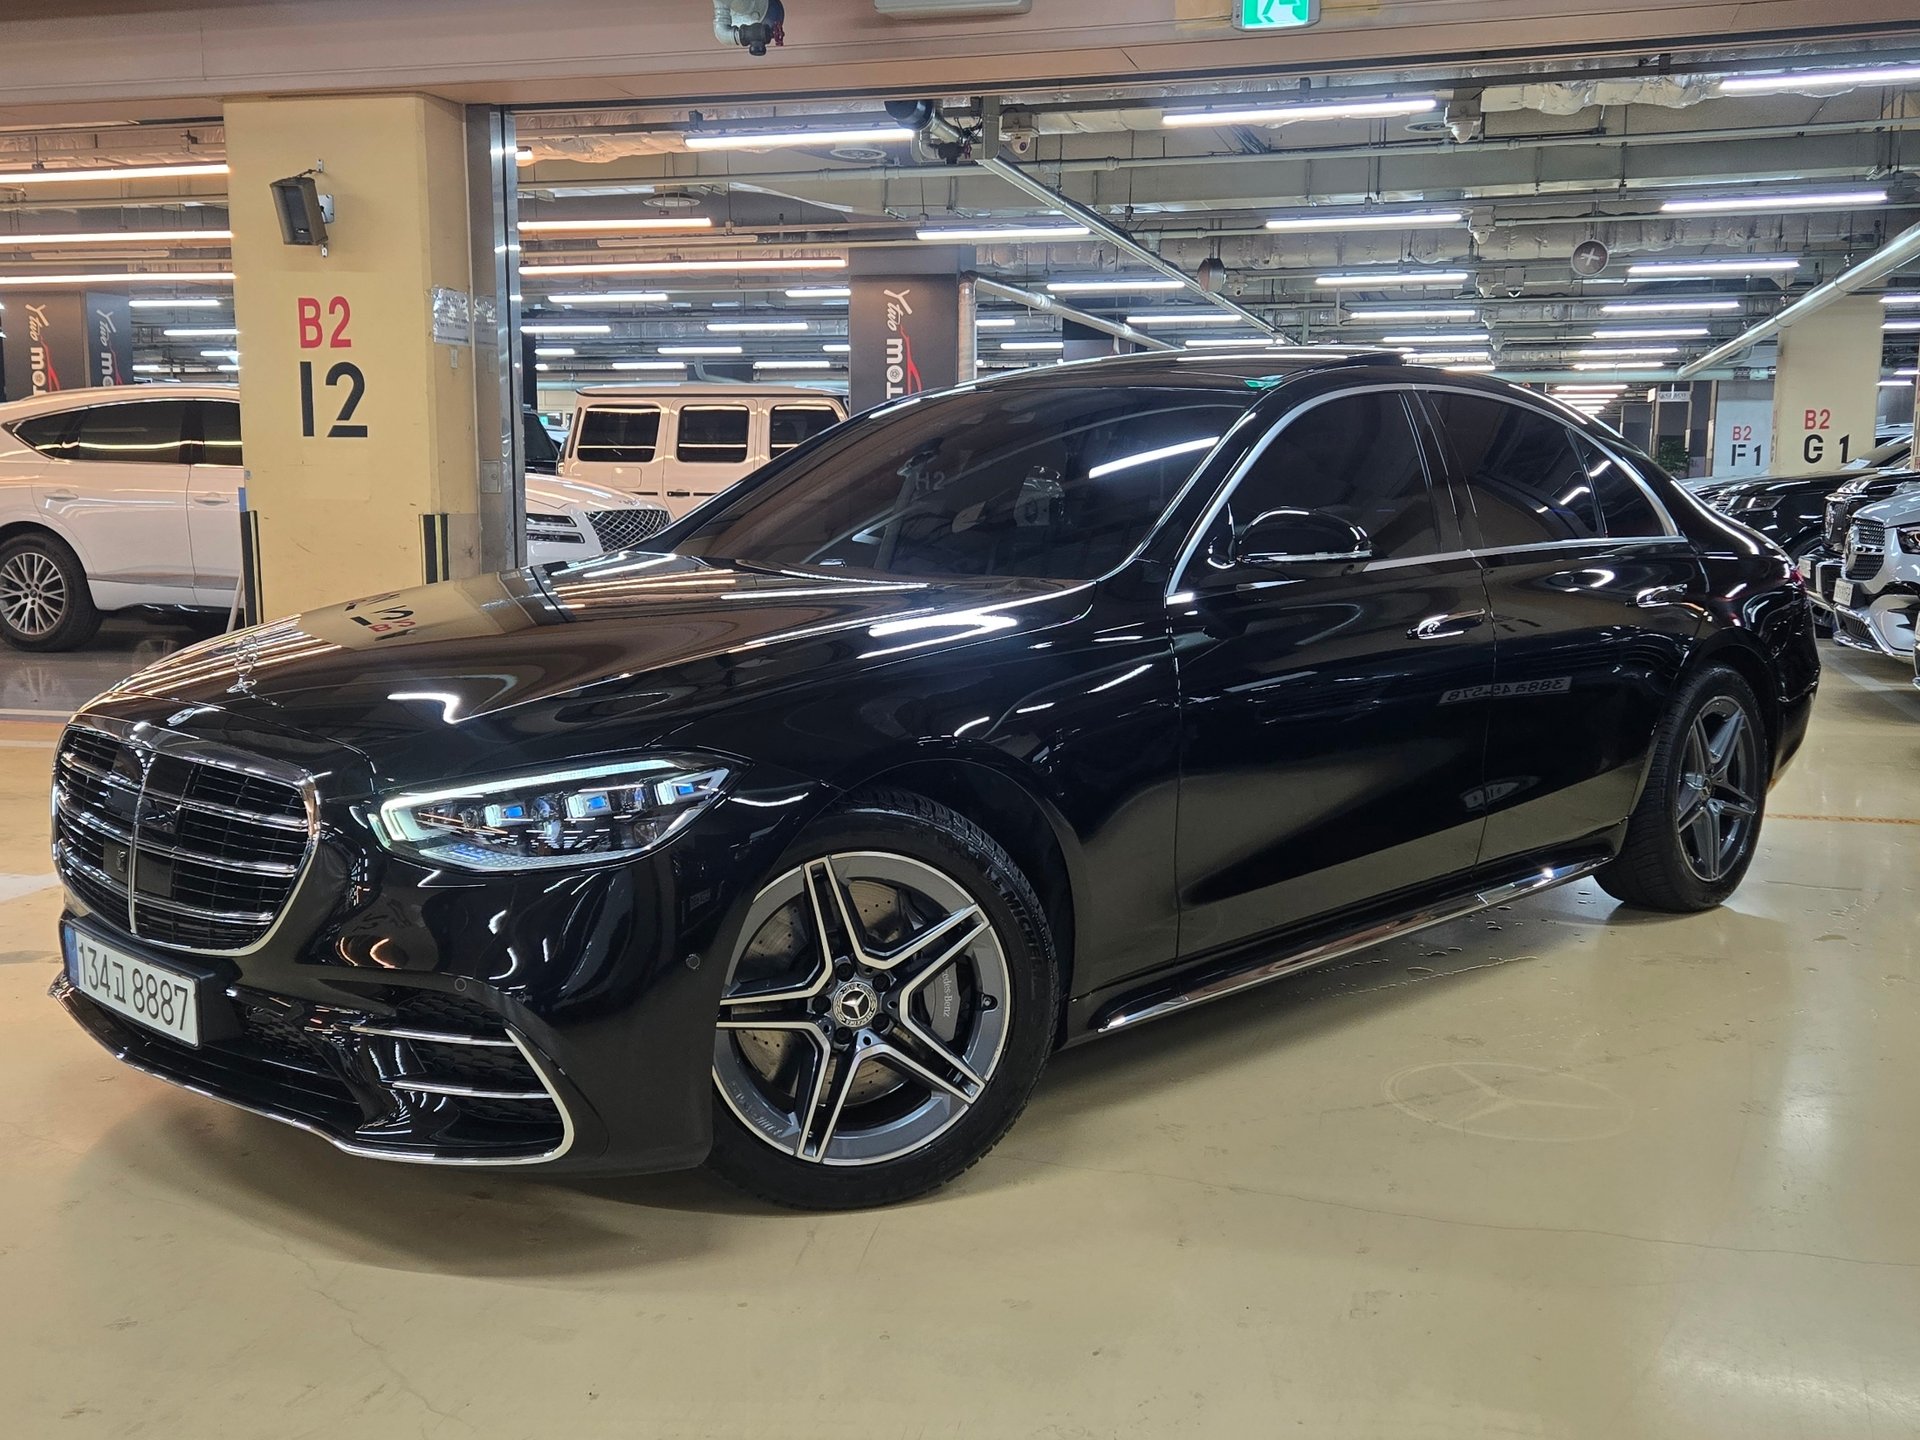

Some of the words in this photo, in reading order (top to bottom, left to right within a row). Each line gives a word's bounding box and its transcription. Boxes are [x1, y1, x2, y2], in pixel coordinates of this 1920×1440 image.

[297, 296, 352, 349] B2
[1732, 425, 1752, 441] B2
[1803, 408, 1831, 430] B2
[132, 967, 188, 1031] 8887
[941, 967, 953, 1017] edes-Benz
